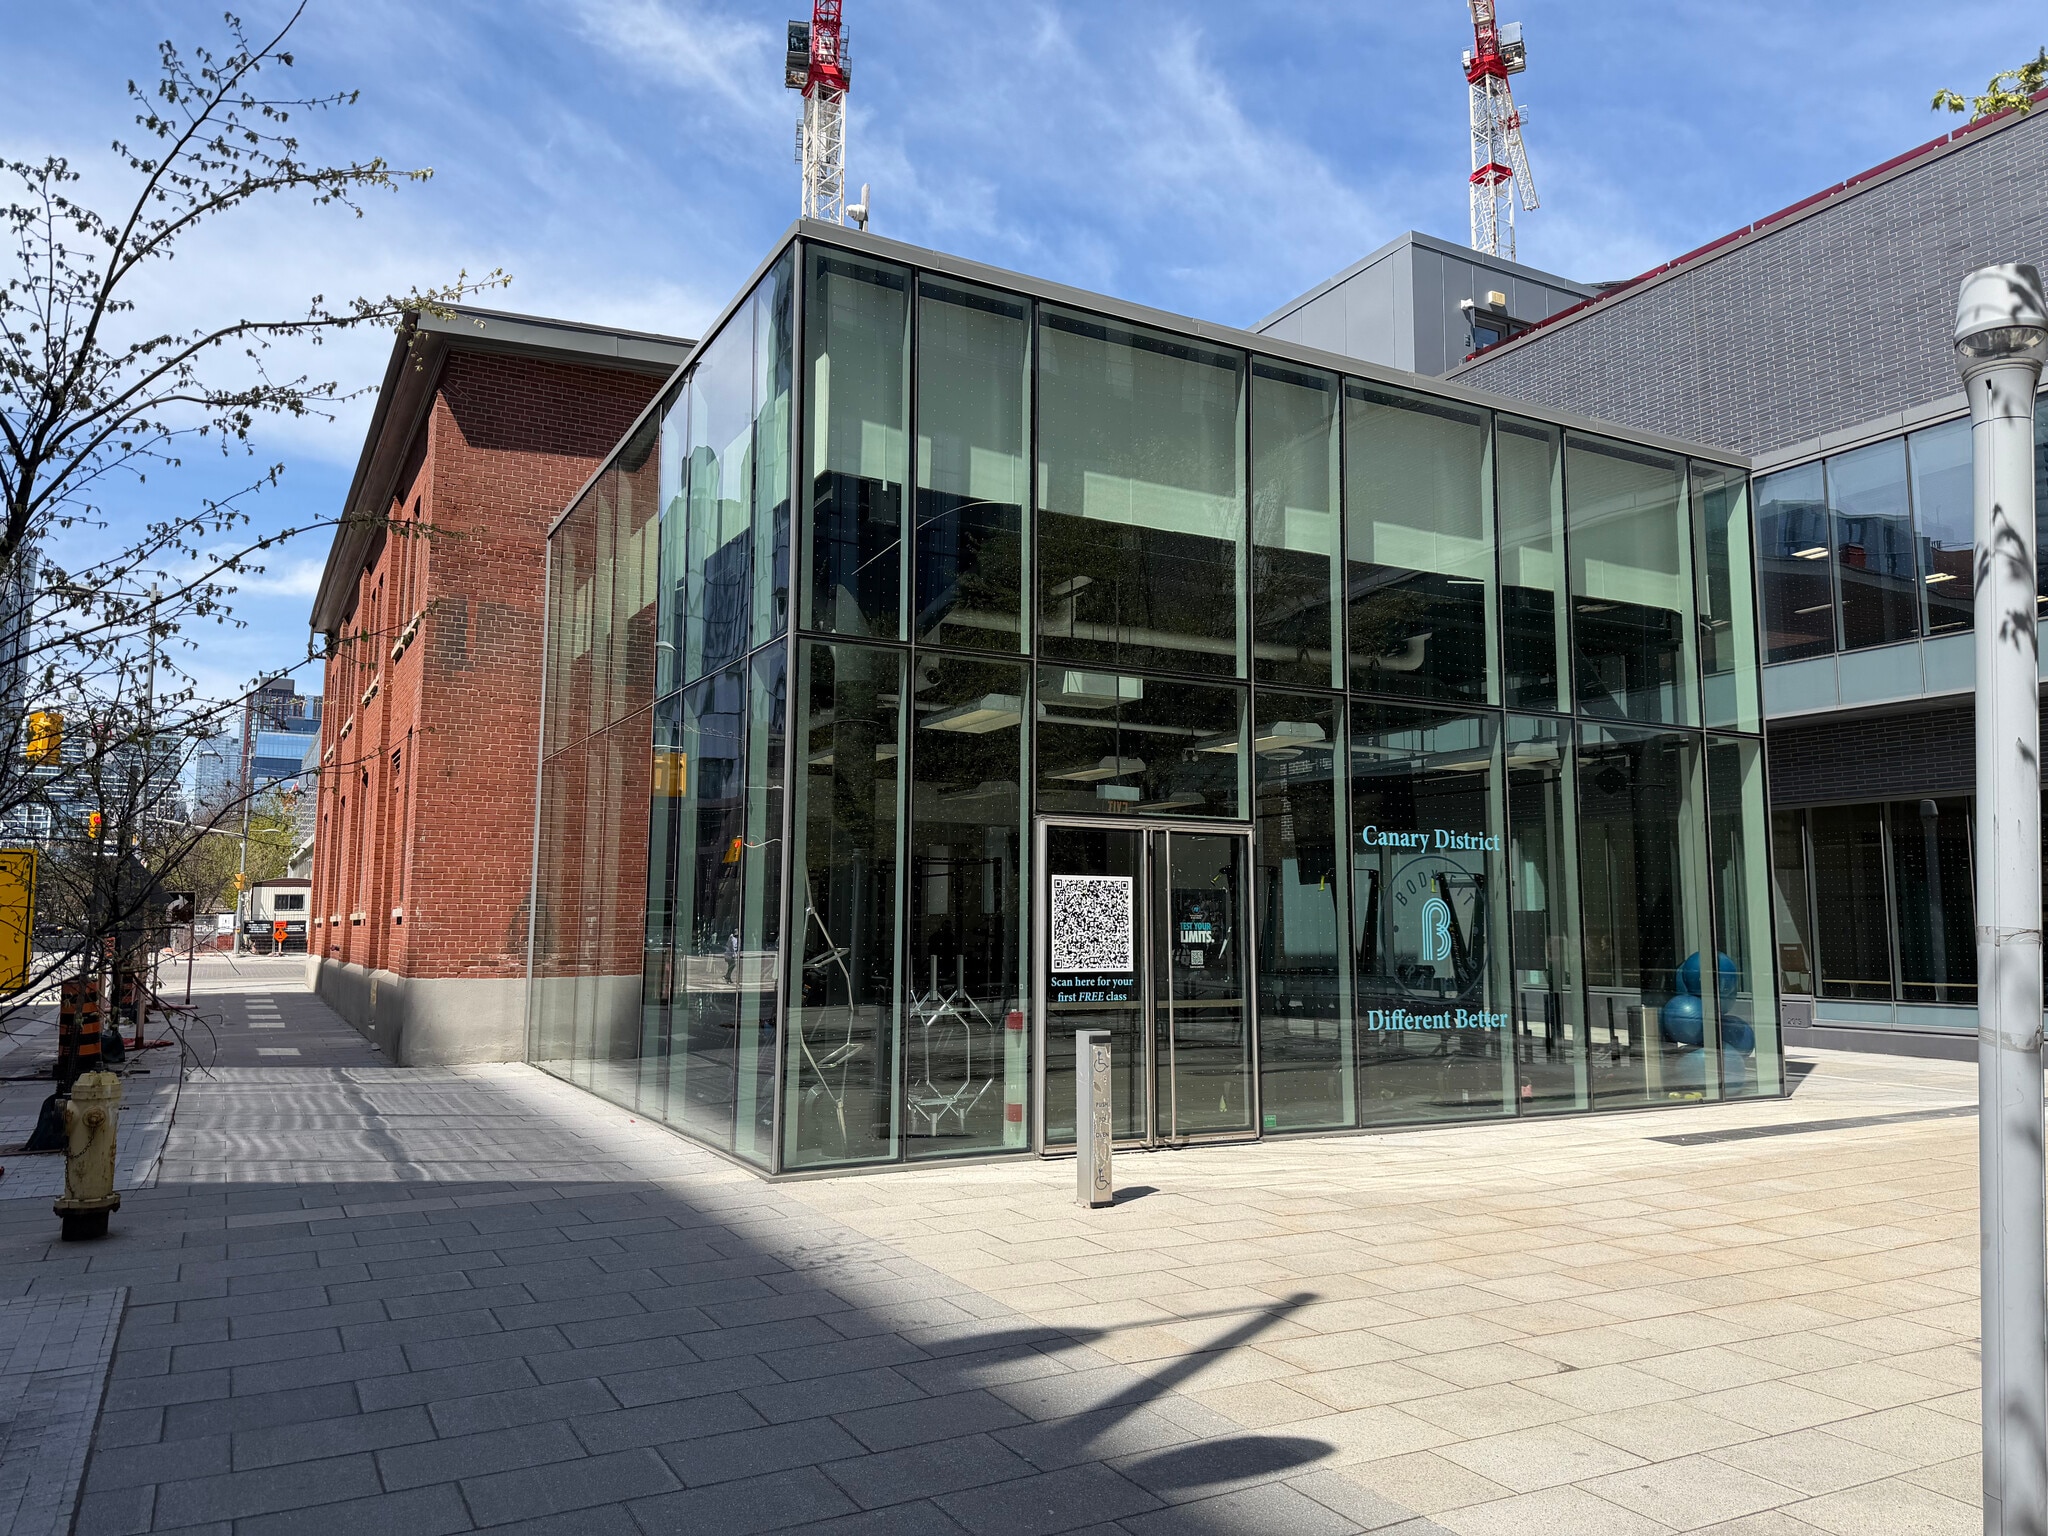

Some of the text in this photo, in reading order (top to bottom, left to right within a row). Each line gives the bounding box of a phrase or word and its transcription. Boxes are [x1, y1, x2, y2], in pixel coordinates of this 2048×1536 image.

[1362, 825, 1501, 854] Canary District
[1180, 922, 1212, 930] TEST YOUR
[1180, 930, 1215, 944] LIMITS.
[1051, 976, 1134, 988] Scan here for your
[1058, 991, 1128, 1002] first FREE class
[1366, 1008, 1509, 1031] Different Better
